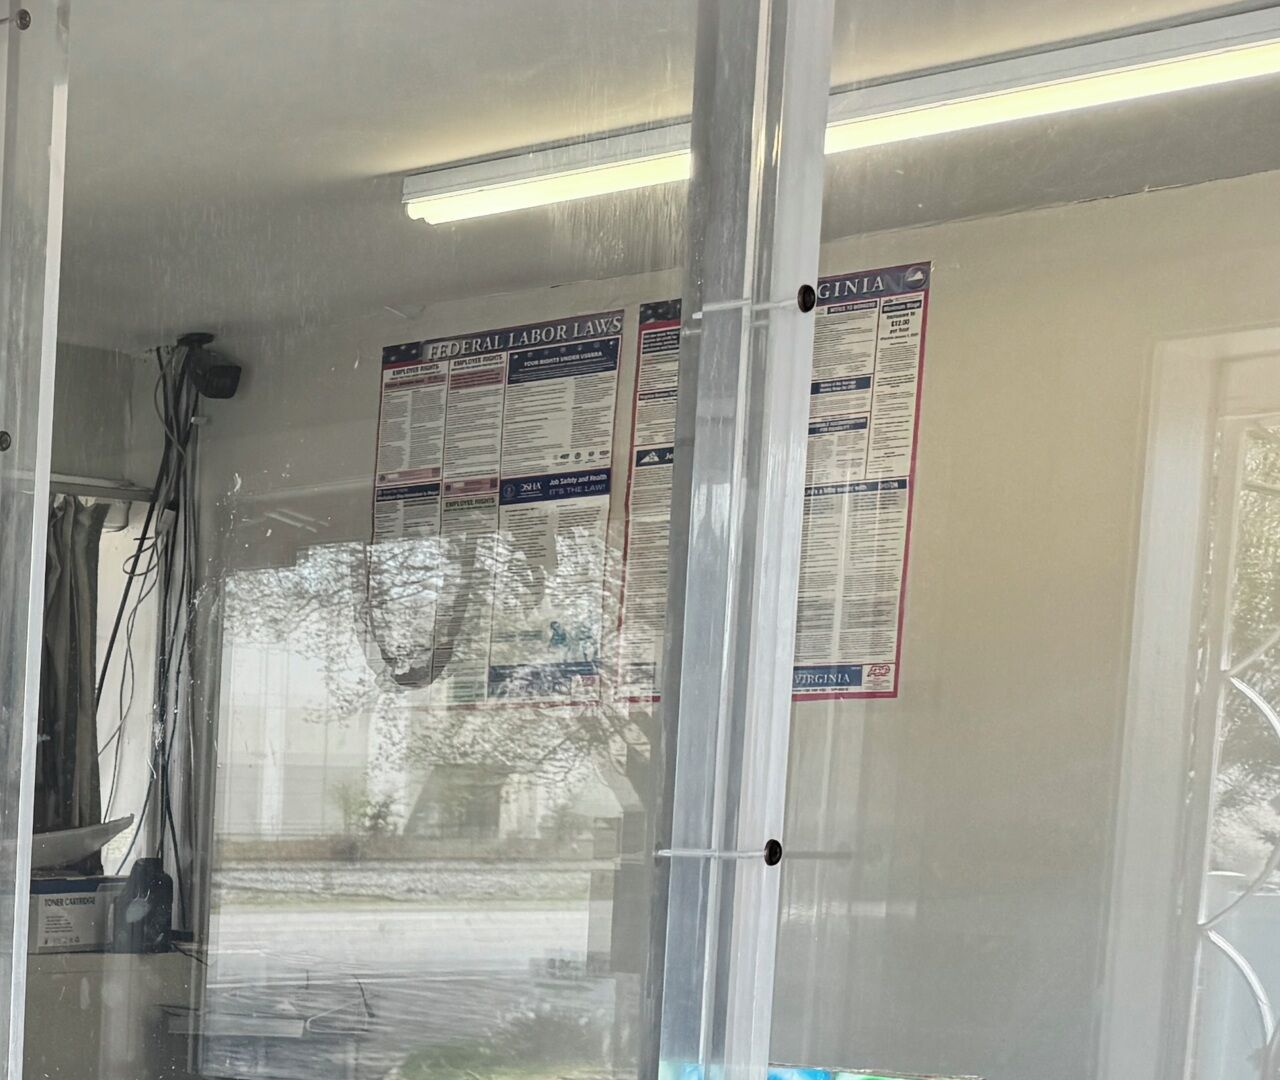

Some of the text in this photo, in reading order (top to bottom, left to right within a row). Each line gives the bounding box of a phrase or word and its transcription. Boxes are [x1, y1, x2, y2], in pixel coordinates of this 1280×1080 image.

[817, 276, 885, 299] GINIA
[430, 315, 622, 360] FEDERAL LABOR LAWS
